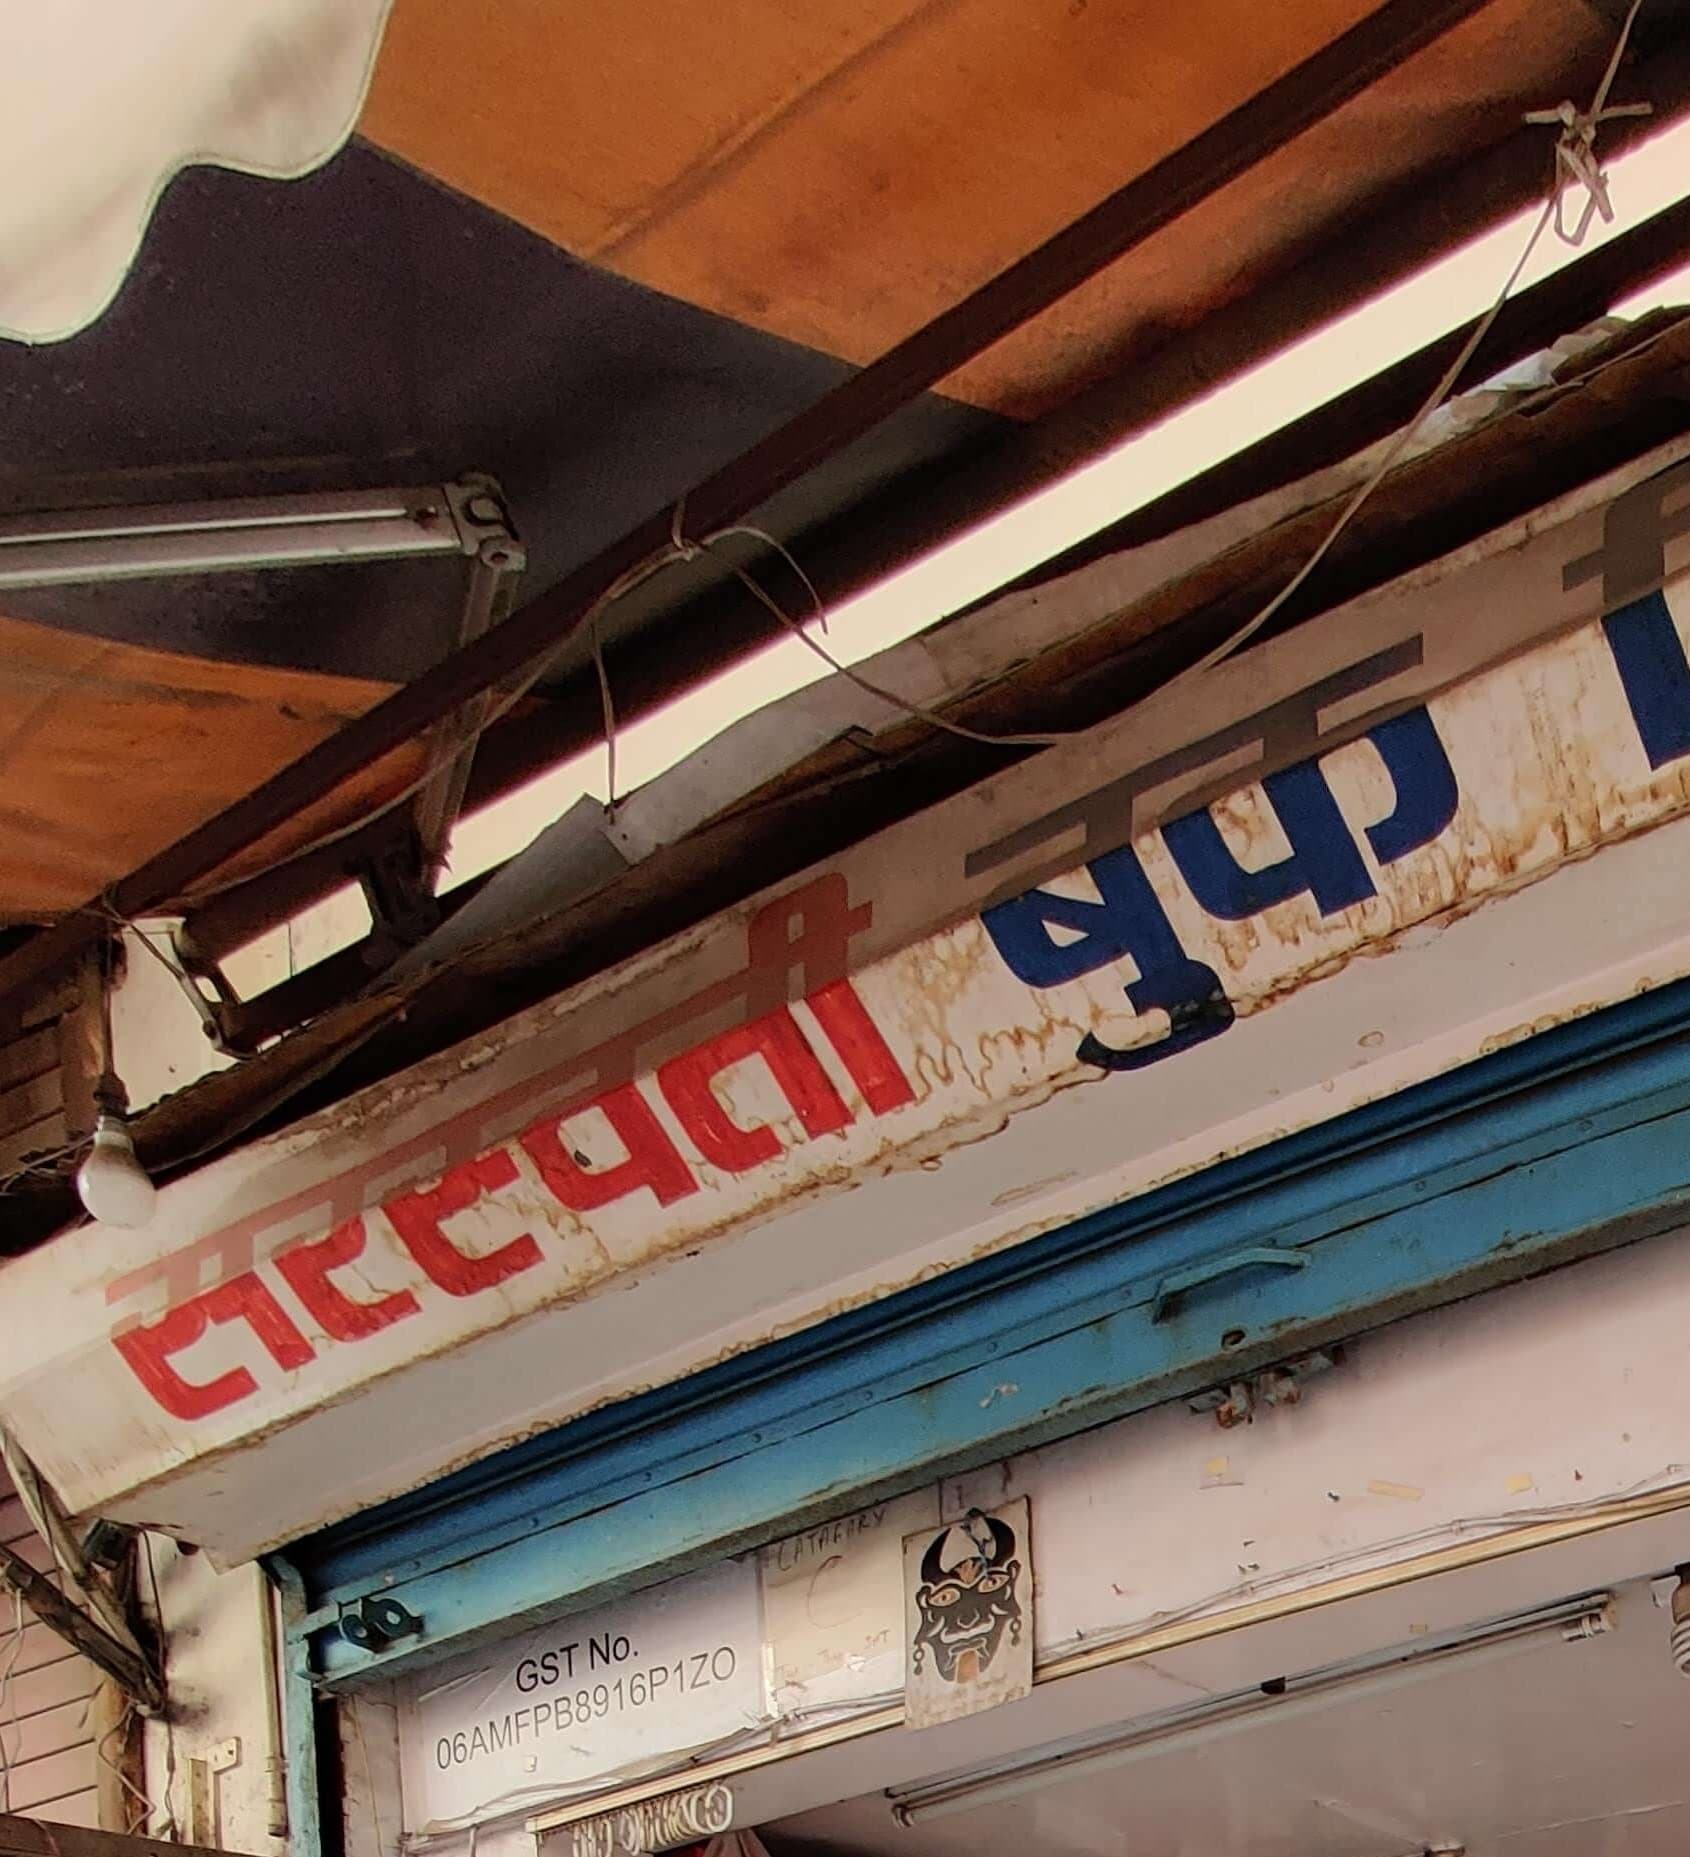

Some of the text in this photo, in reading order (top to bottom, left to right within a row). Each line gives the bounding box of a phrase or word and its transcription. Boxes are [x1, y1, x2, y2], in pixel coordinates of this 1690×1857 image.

[962, 635, 1463, 1073] बुक
[515, 1630, 639, 1693] GST No.
